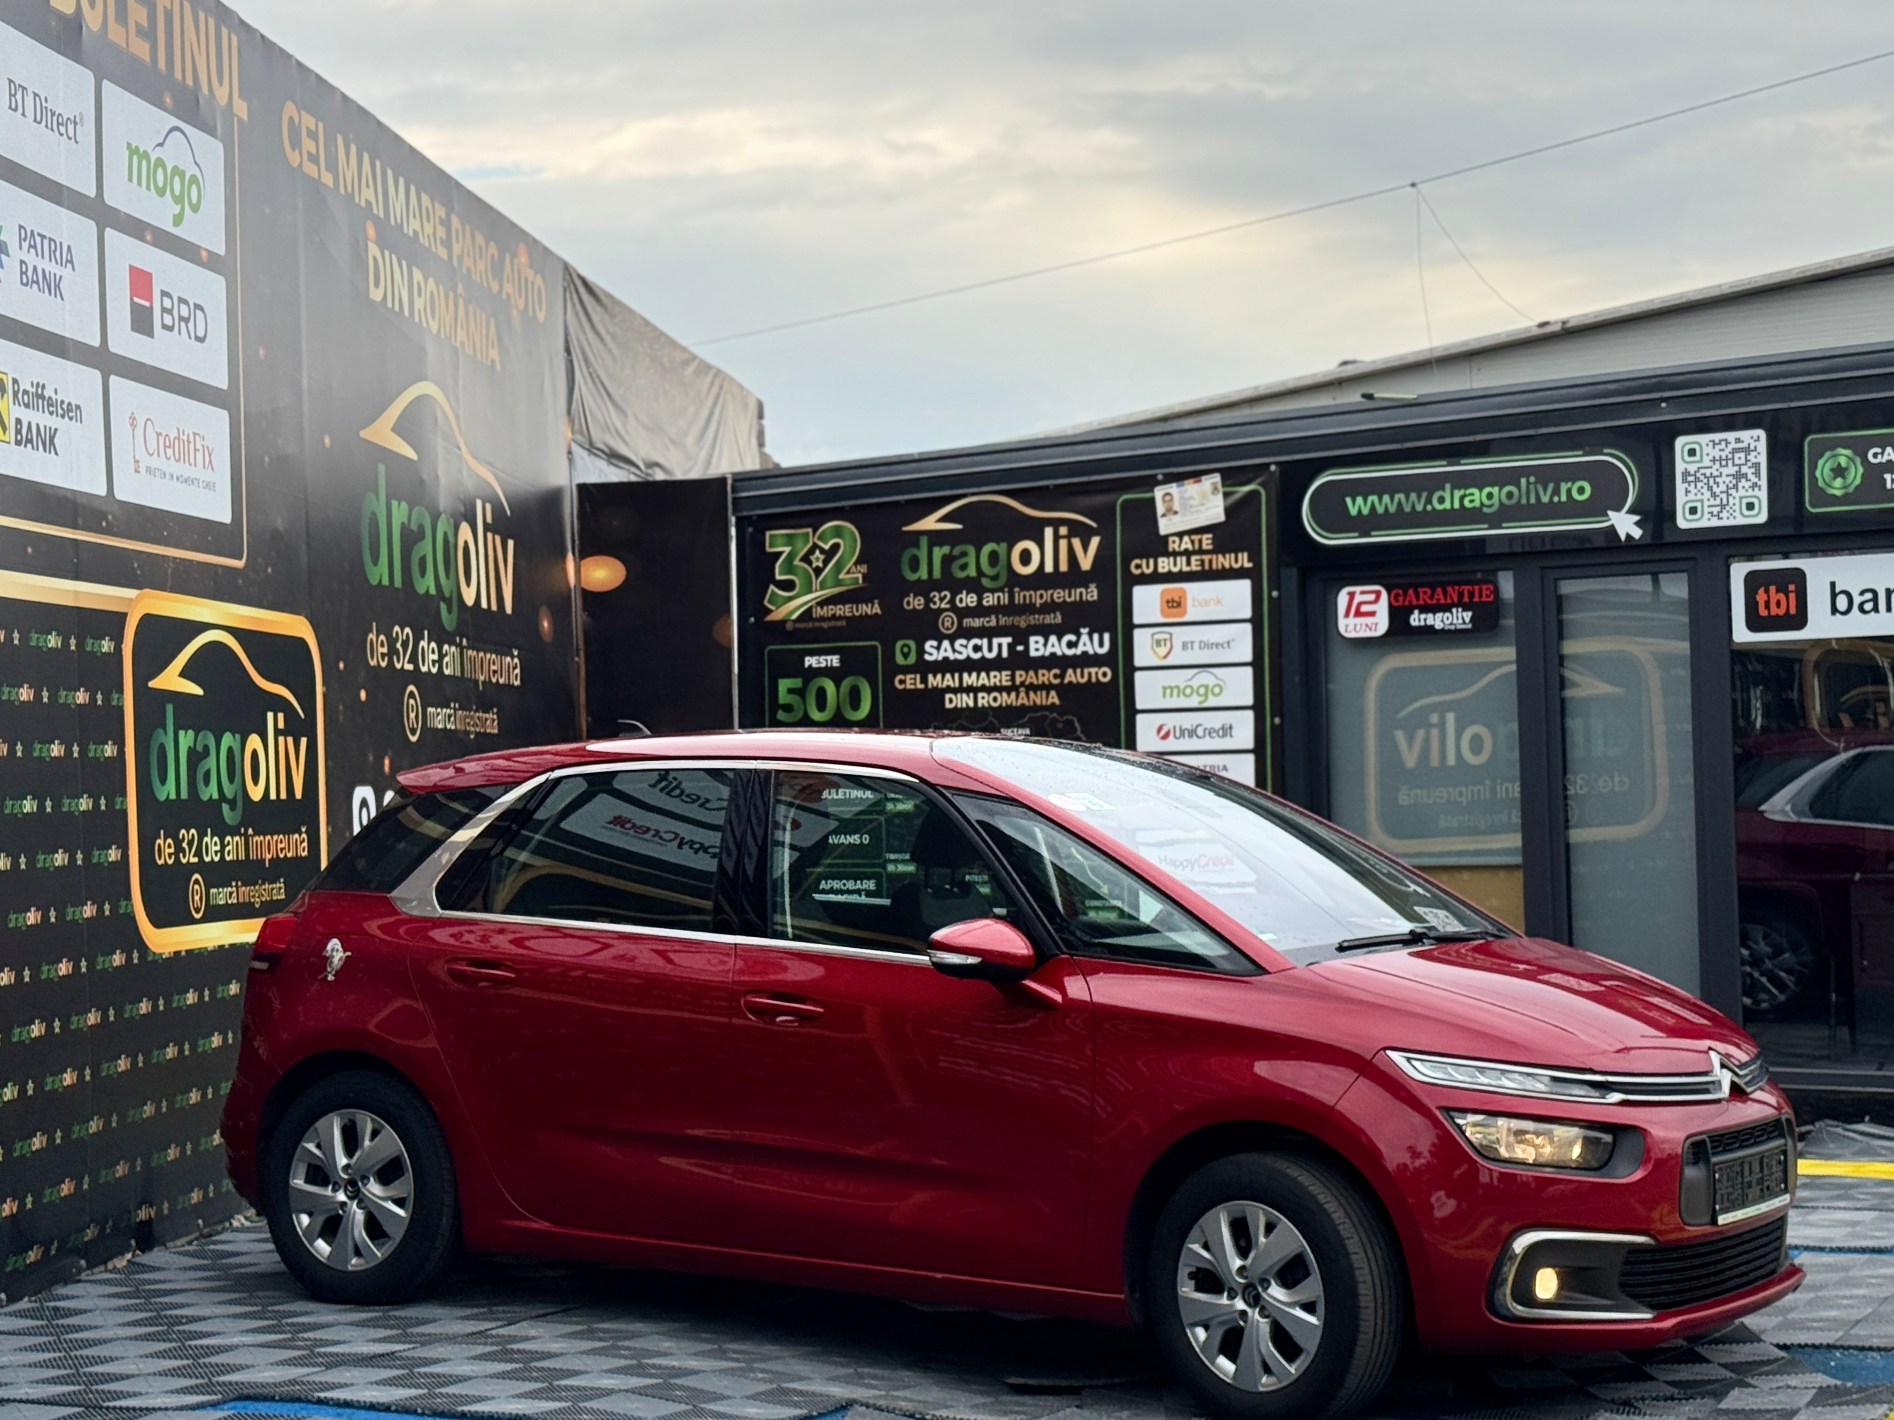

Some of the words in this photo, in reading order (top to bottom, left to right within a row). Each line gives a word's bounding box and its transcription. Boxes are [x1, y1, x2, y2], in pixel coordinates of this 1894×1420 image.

[7, 77, 28, 118] BT
[126, 141, 202, 227] mogo
[281, 101, 333, 189] CEL
[337, 134, 384, 219] MAI
[387, 168, 448, 261] MARE
[451, 214, 499, 294] PARC
[502, 253, 546, 323] AUTO
[18, 224, 75, 272] PATRIA
[20, 259, 64, 301] BANK
[160, 289, 207, 344] BRD
[367, 241, 409, 317] DIN
[413, 266, 500, 371] ROMÂNIA
[12, 377, 83, 424] Raiffeisen
[14, 417, 59, 456] BANK
[143, 417, 215, 472] CreditFix
[1345, 475, 1592, 517] www.dragoliv.ro
[361, 463, 515, 631] dragoliv
[902, 526, 1101, 589] dragoliv
[1168, 533, 1213, 552] RATE
[850, 564, 867, 574] ANI
[1130, 558, 1154, 575] CU
[1157, 552, 1253, 573] BULETINUL
[812, 600, 882, 619] ÎMPREUNĂ
[903, 593, 924, 610] de
[929, 591, 951, 609] 32
[955, 590, 978, 608] de
[982, 588, 1008, 606] ani
[1013, 583, 1098, 608] împreună
[1165, 596, 1182, 609] tbi
[1192, 595, 1224, 608] bank
[1343, 590, 1382, 619] 12
[1390, 584, 1494, 606] GARANTIE
[1756, 584, 1797, 617] tbi
[963, 614, 997, 628] marcă
[998, 611, 1062, 628] înregistrată
[1345, 622, 1379, 633] LUNI
[1410, 607, 1472, 629] dragoliv
[367, 622, 388, 668] de
[393, 625, 414, 671] 32
[418, 630, 438, 674] de
[443, 636, 461, 677] ani
[462, 637, 521, 691] împreună
[924, 637, 1012, 661] SASCUT
[1029, 627, 1110, 657] BACĂU
[1155, 638, 1169, 648] BT
[1181, 641, 1196, 651] BT
[804, 655, 840, 668] PESTE
[894, 673, 924, 689] CEL
[927, 672, 959, 689] MAI
[962, 670, 1012, 688] MARE
[1015, 669, 1061, 686] PARC
[1063, 667, 1112, 684] AUTO
[775, 675, 872, 723] 500
[945, 692, 974, 709] DIN
[977, 688, 1060, 708] ROMÂNIA
[1162, 683, 1223, 705] mogo
[427, 702, 455, 729] marcă
[455, 702, 498, 739] înregistrată
[1173, 723, 1233, 740] UniCredit
[150, 704, 307, 825] dragoliv
[155, 829, 175, 866] de
[179, 828, 199, 864] 32
[202, 828, 221, 863] de
[224, 827, 245, 861] ani
[248, 825, 308, 868] împreună
[210, 880, 237, 905] marcă
[238, 878, 286, 908] înregistrată
[819, 879, 877, 891] APROBARE
